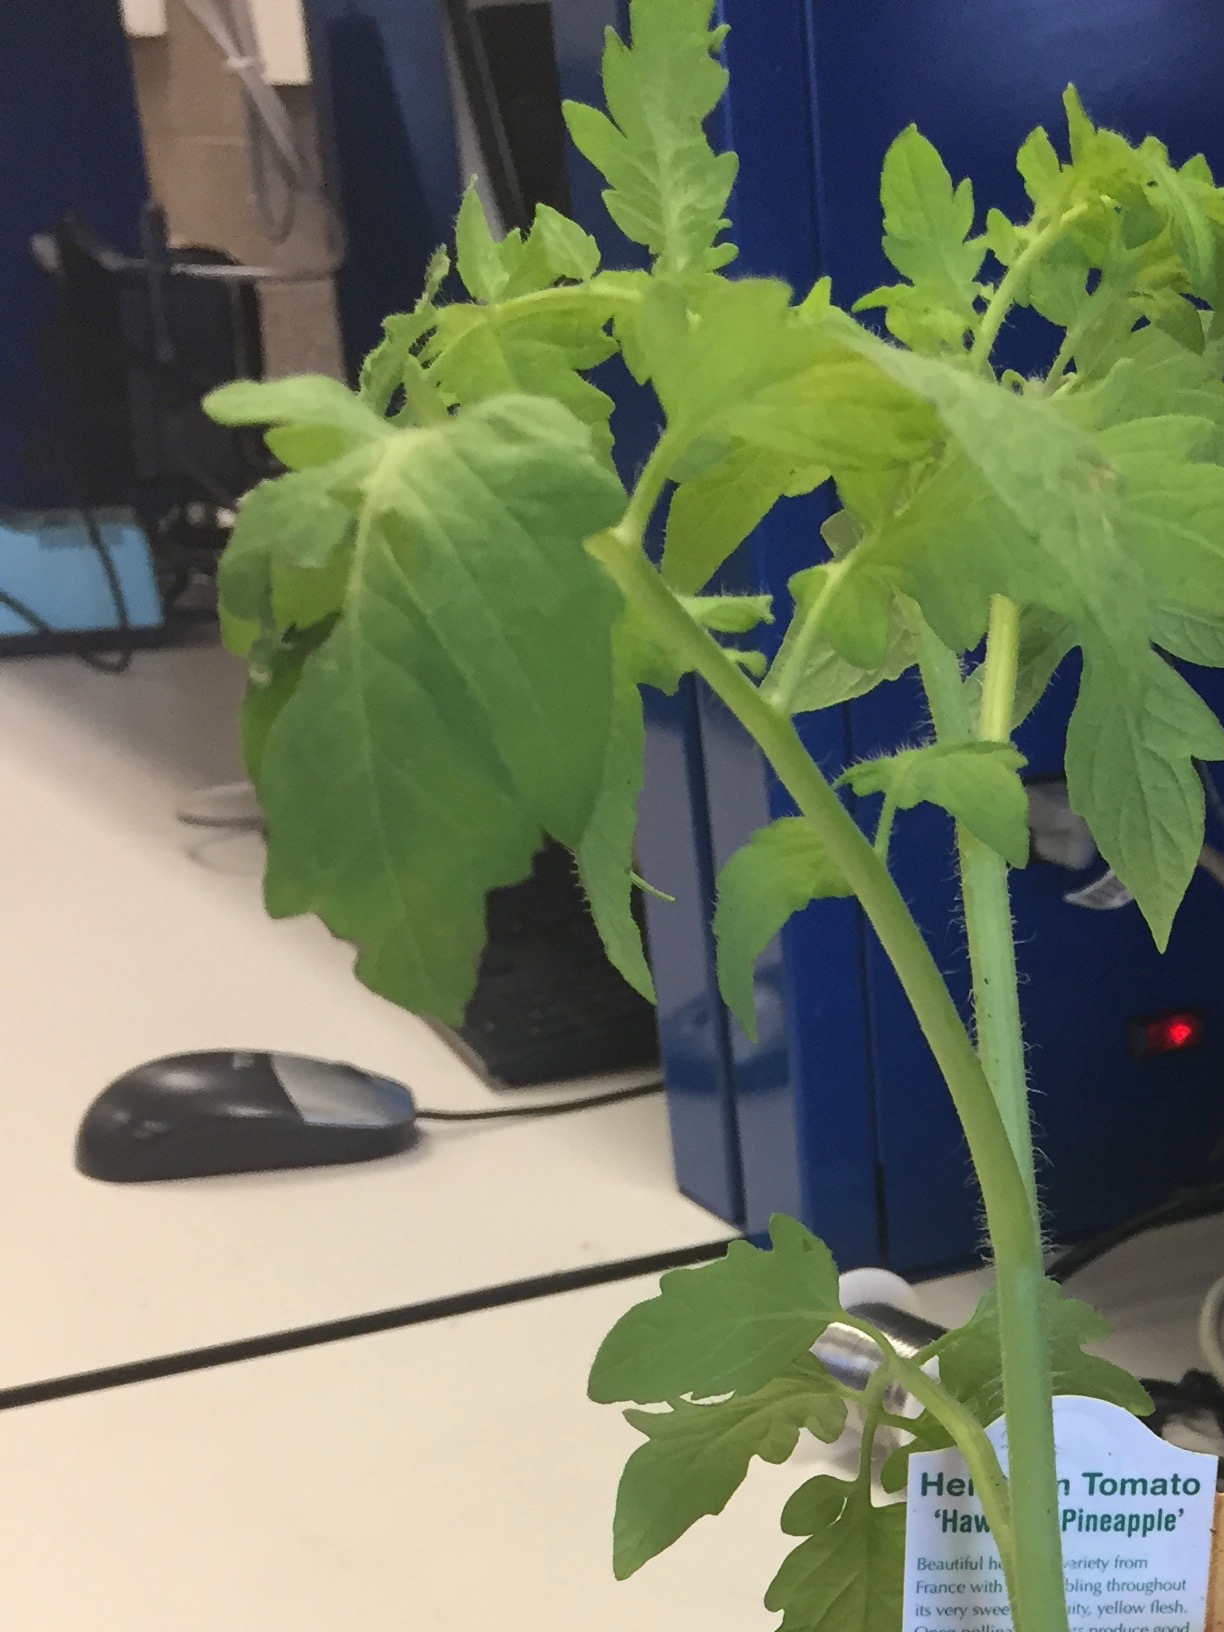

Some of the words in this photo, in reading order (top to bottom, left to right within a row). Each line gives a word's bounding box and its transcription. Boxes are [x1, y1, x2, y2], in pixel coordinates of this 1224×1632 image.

[1082, 1471, 1201, 1497] Tomato
[916, 1556, 983, 1571] Beautiful
[1114, 1555, 1148, 1569] from
[916, 1580, 966, 1594] France
[970, 1579, 1003, 1593] with
[1106, 1577, 1187, 1596] throughout
[914, 1604, 931, 1617] its
[936, 1605, 968, 1621] very
[972, 1605, 1011, 1617] swee
[1096, 1600, 1145, 1619] yellow
[1149, 1599, 1188, 1615] flesh.
